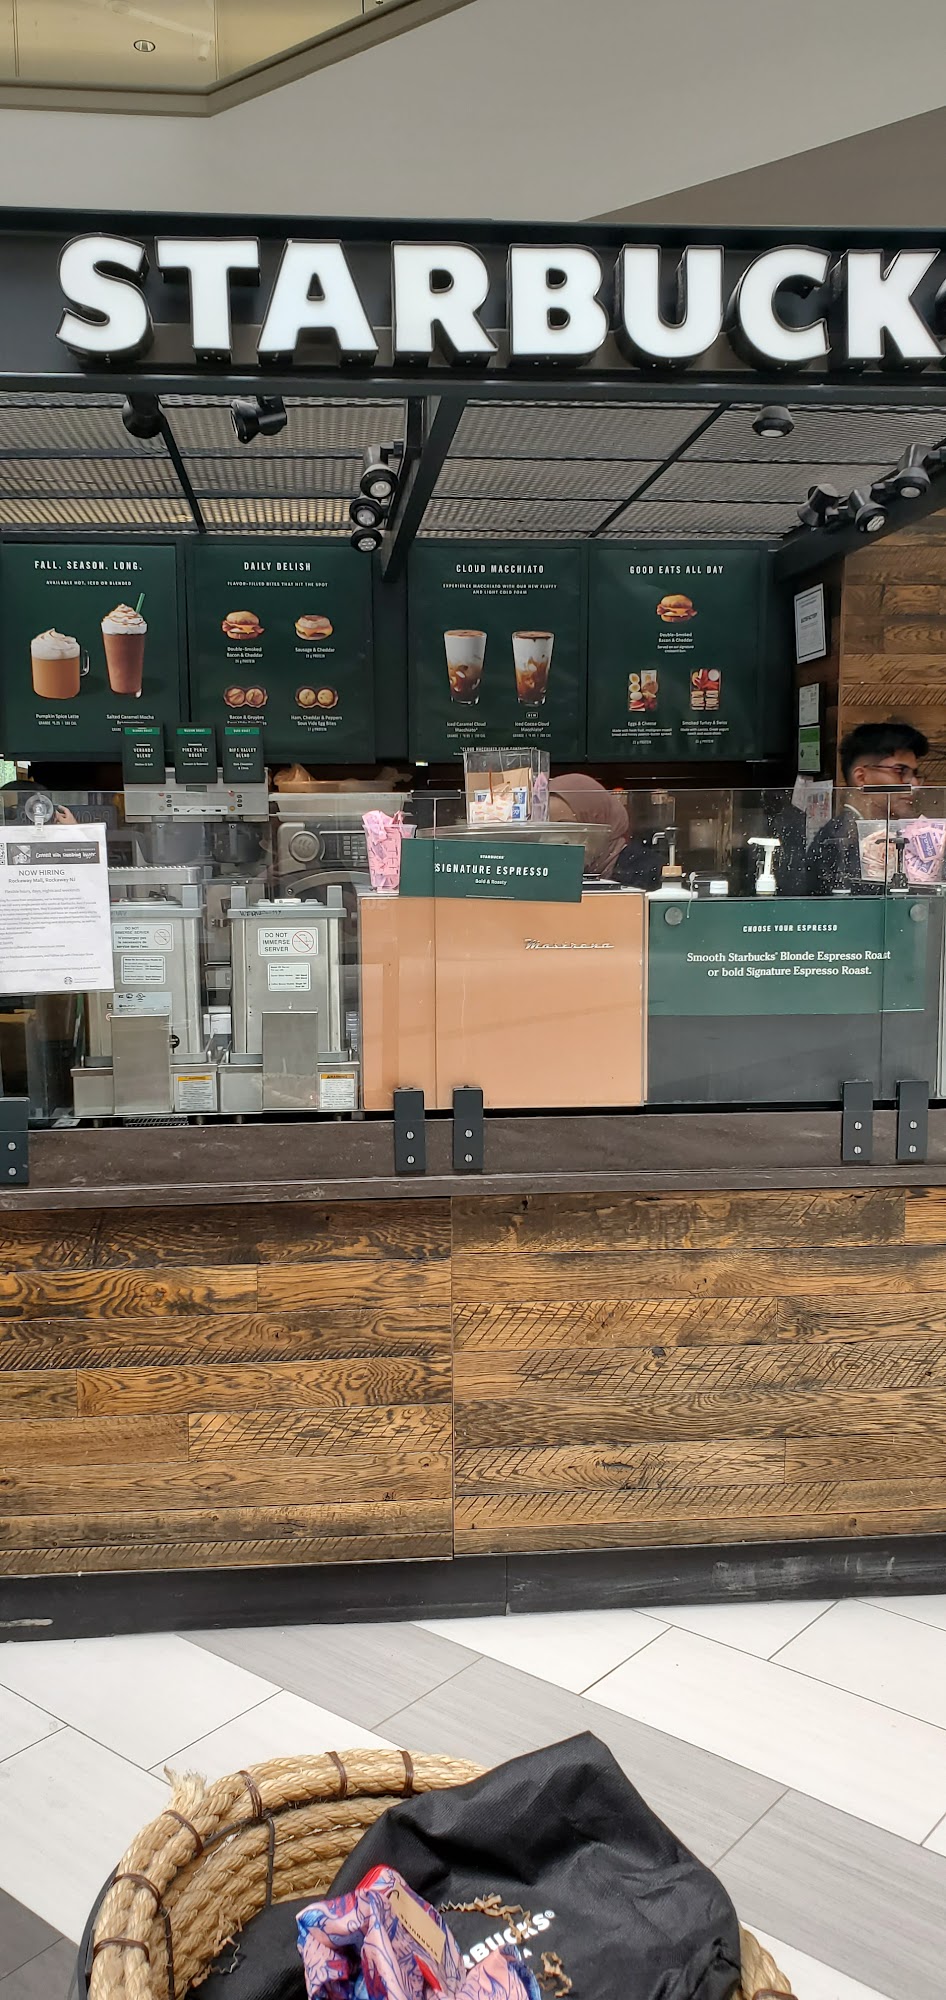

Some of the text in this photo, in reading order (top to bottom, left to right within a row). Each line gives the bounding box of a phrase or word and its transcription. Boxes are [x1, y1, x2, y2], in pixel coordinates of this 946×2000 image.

[57, 233, 946, 363] STARBUCK
[35, 560, 143, 571] FALL. SEASON. LONG.
[244, 561, 312, 571] DAILY DELISH
[456, 564, 545, 574] CLOUD MACCHIATO
[629, 565, 724, 574] GOOD EATS ALL DAY
[435, 863, 549, 877] SIGNATURE ESPRESSO
[743, 924, 838, 933] CHOOSE YOUR ESPRESSO
[687, 951, 726, 962] Smooth
[780, 950, 815, 961] Blonde
[817, 951, 863, 963] Espresso
[864, 949, 892, 960] Roast
[707, 965, 872, 978] or bold Signature Espresso Roast.
